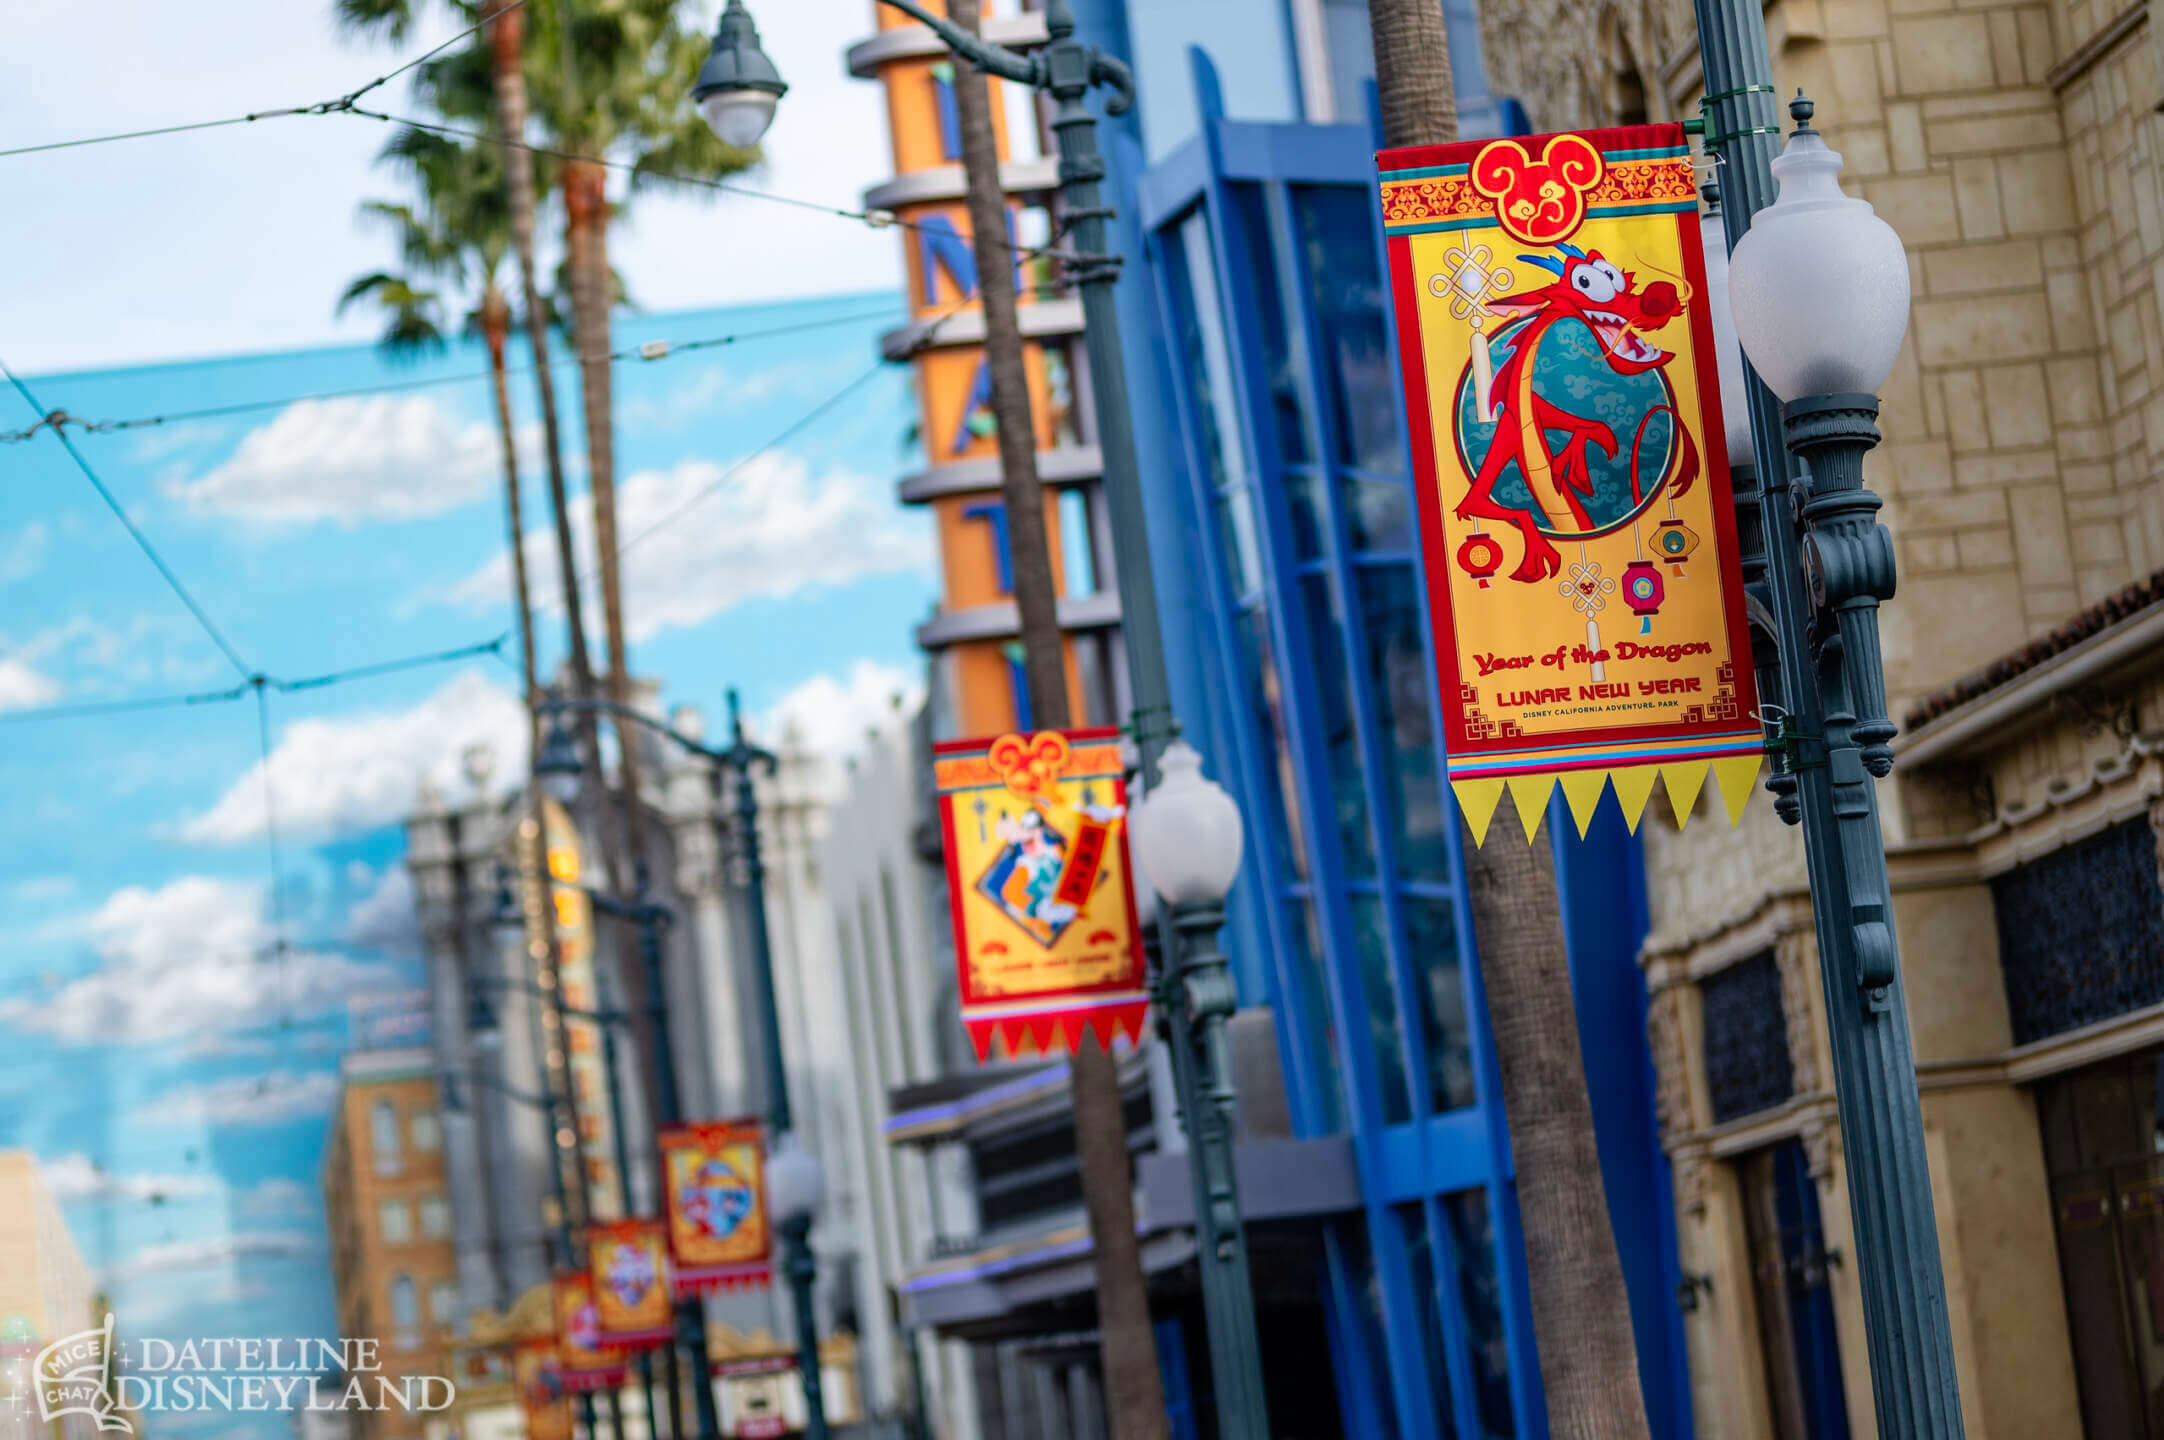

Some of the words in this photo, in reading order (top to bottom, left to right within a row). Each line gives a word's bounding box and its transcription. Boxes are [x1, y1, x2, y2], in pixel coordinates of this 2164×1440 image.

[1473, 653, 1534, 677] Year
[1541, 645, 1567, 670] of
[1571, 644, 1611, 664] the
[1614, 641, 1713, 663] Dragon
[1496, 687, 1572, 707] LUNAR
[1579, 682, 1630, 700] NEW
[1638, 677, 1702, 695] YEAR
[1523, 710, 1552, 718] DISNEY
[1554, 706, 1603, 715] CALIFORNIA
[1658, 700, 1679, 708] PARK
